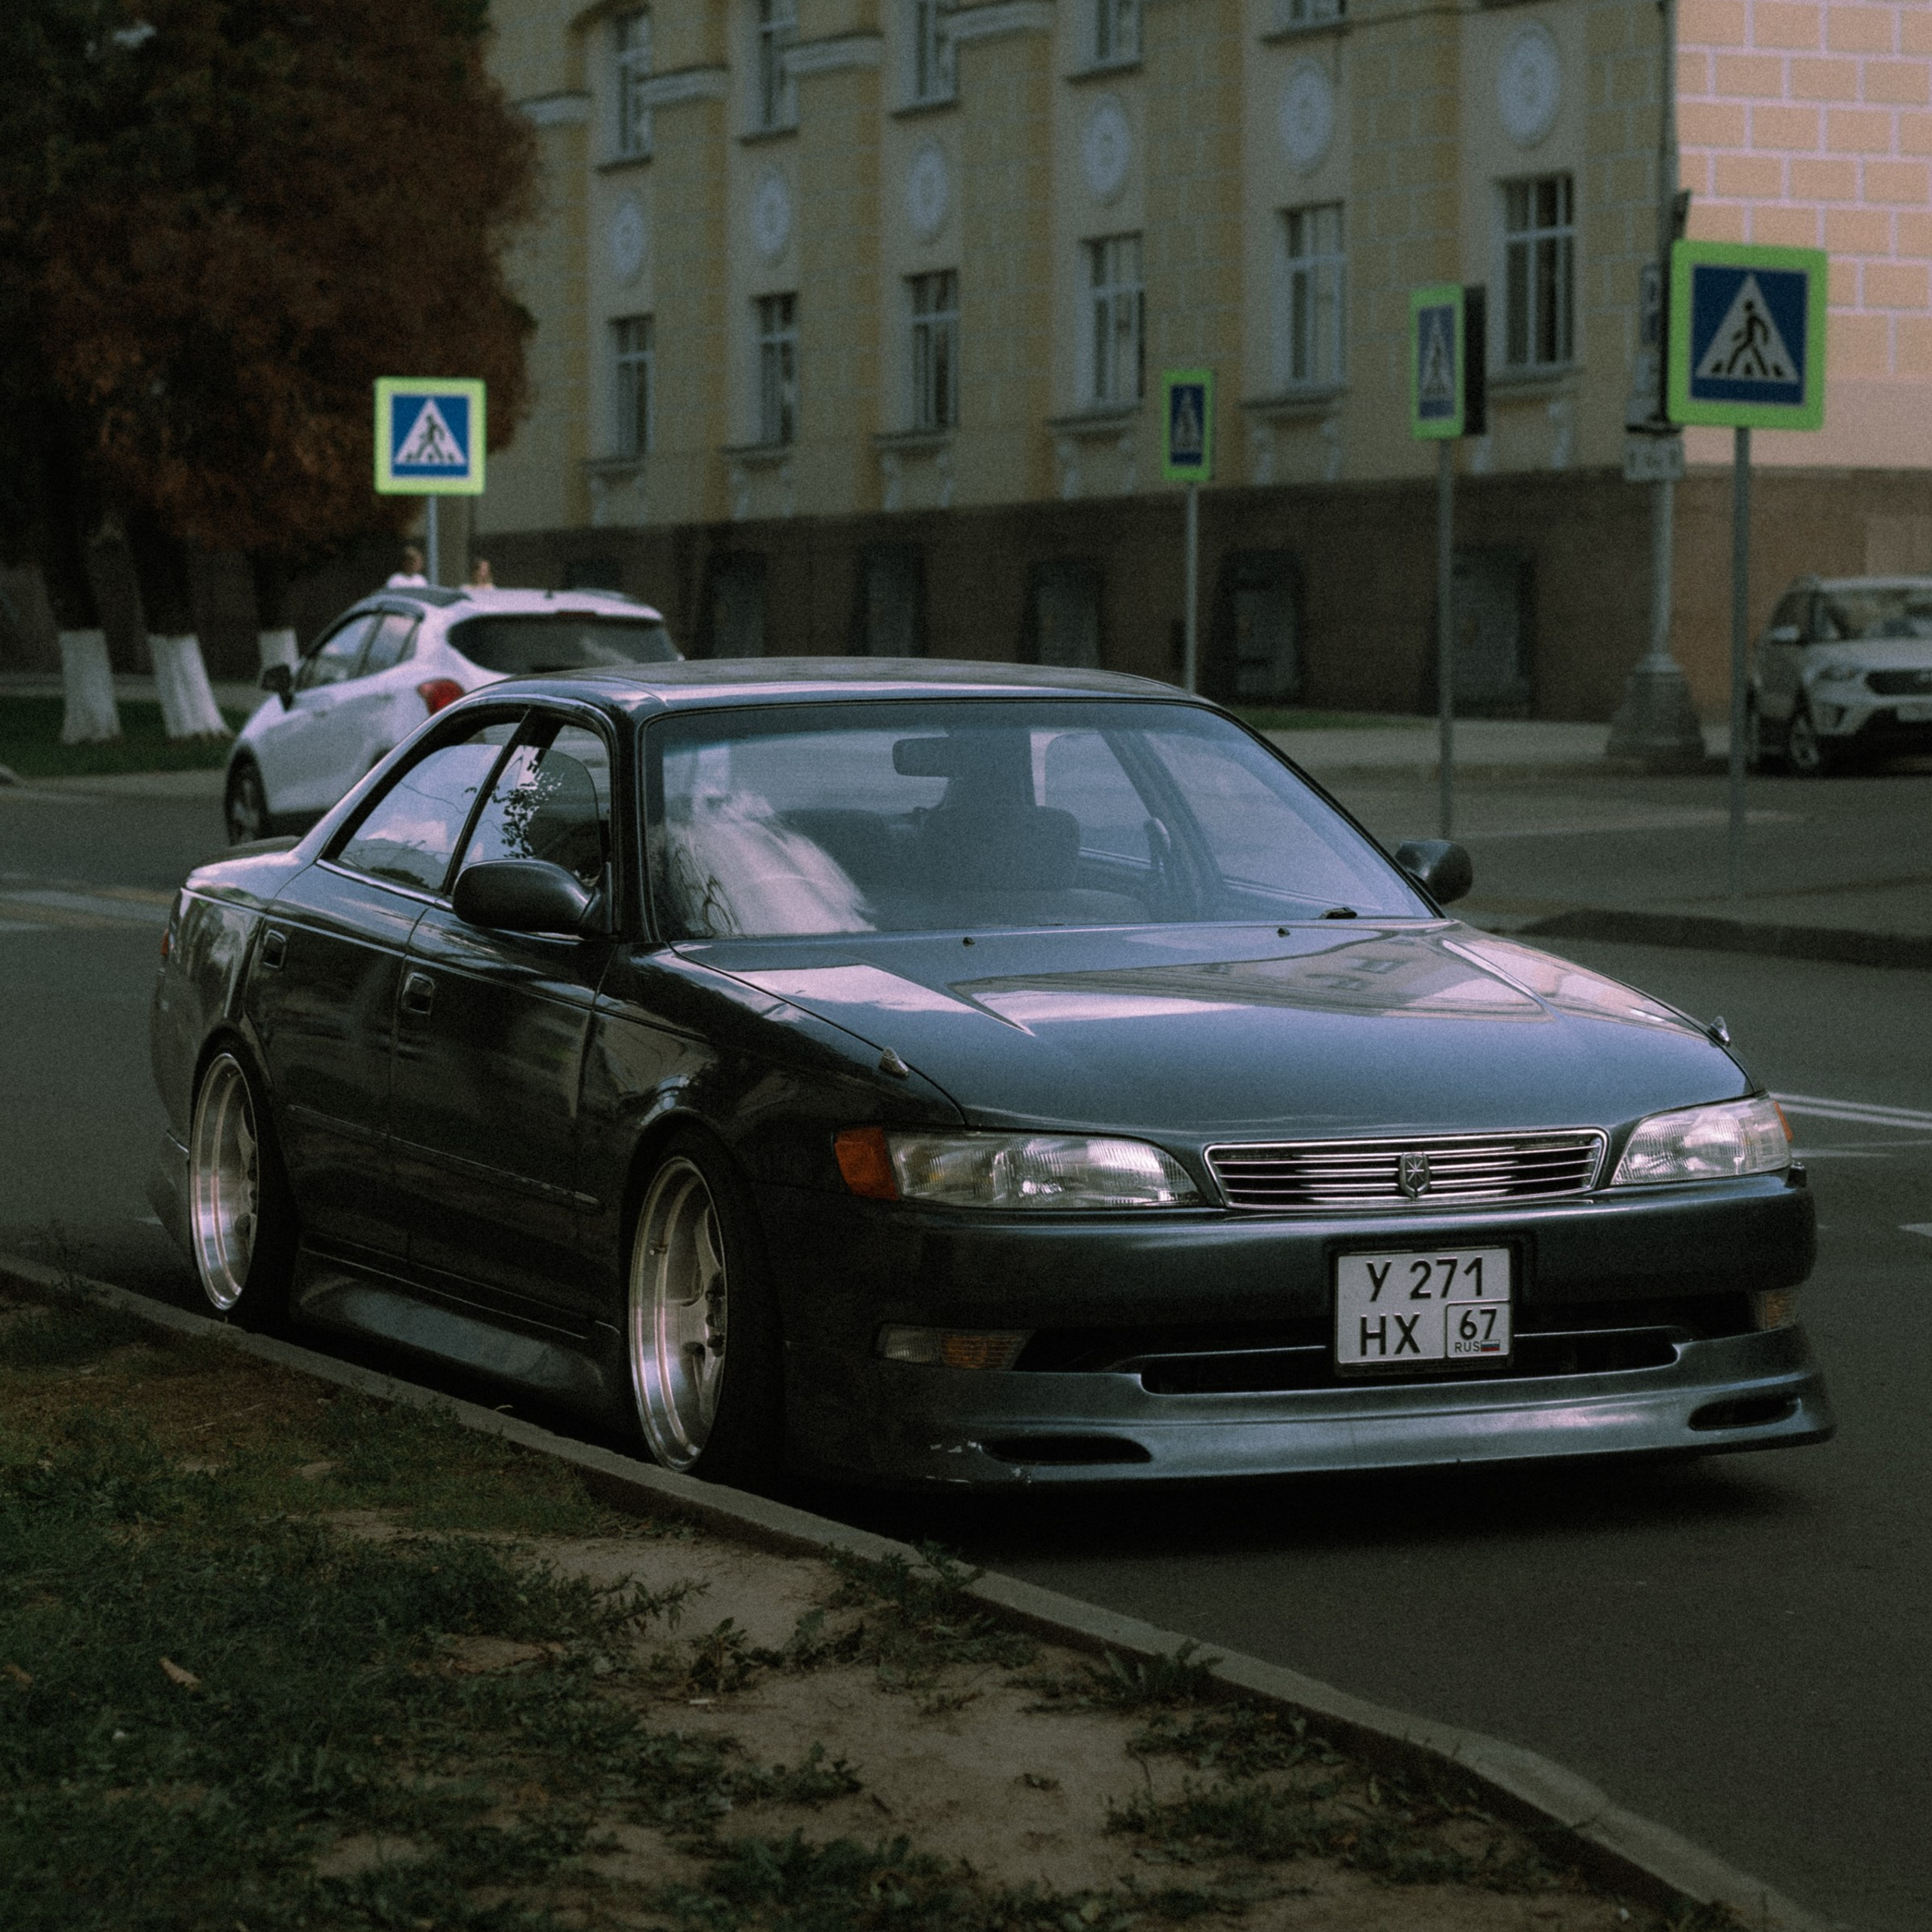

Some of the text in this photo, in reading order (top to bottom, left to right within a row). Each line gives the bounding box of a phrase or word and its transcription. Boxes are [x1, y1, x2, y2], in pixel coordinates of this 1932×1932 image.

[1409, 1257, 1482, 1300] 271
[1460, 1307, 1497, 1340] 67
[1454, 1341, 1480, 1353] RUS
